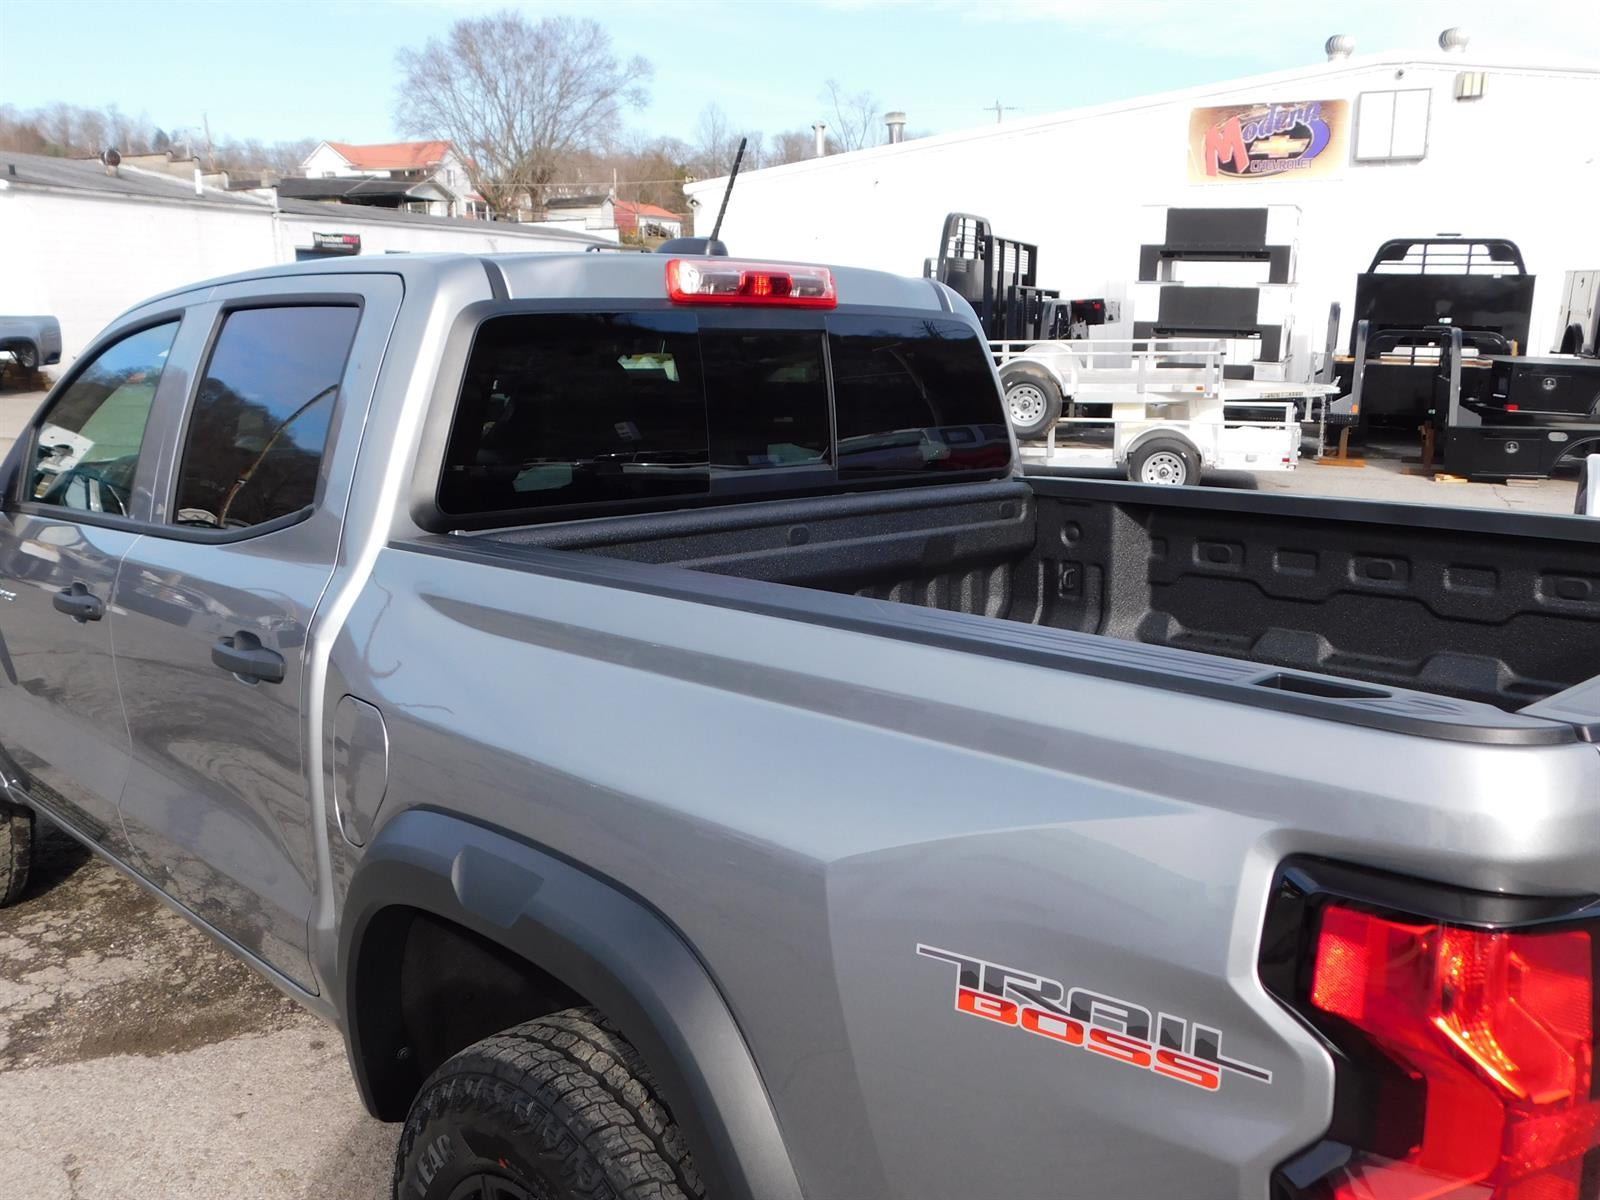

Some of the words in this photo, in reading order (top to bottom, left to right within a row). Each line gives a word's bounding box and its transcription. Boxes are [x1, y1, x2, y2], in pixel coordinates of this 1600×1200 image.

[1205, 101, 1322, 176] Modern
[916, 943, 1272, 1084] TRAIL
[954, 985, 1222, 1092] BOSS
